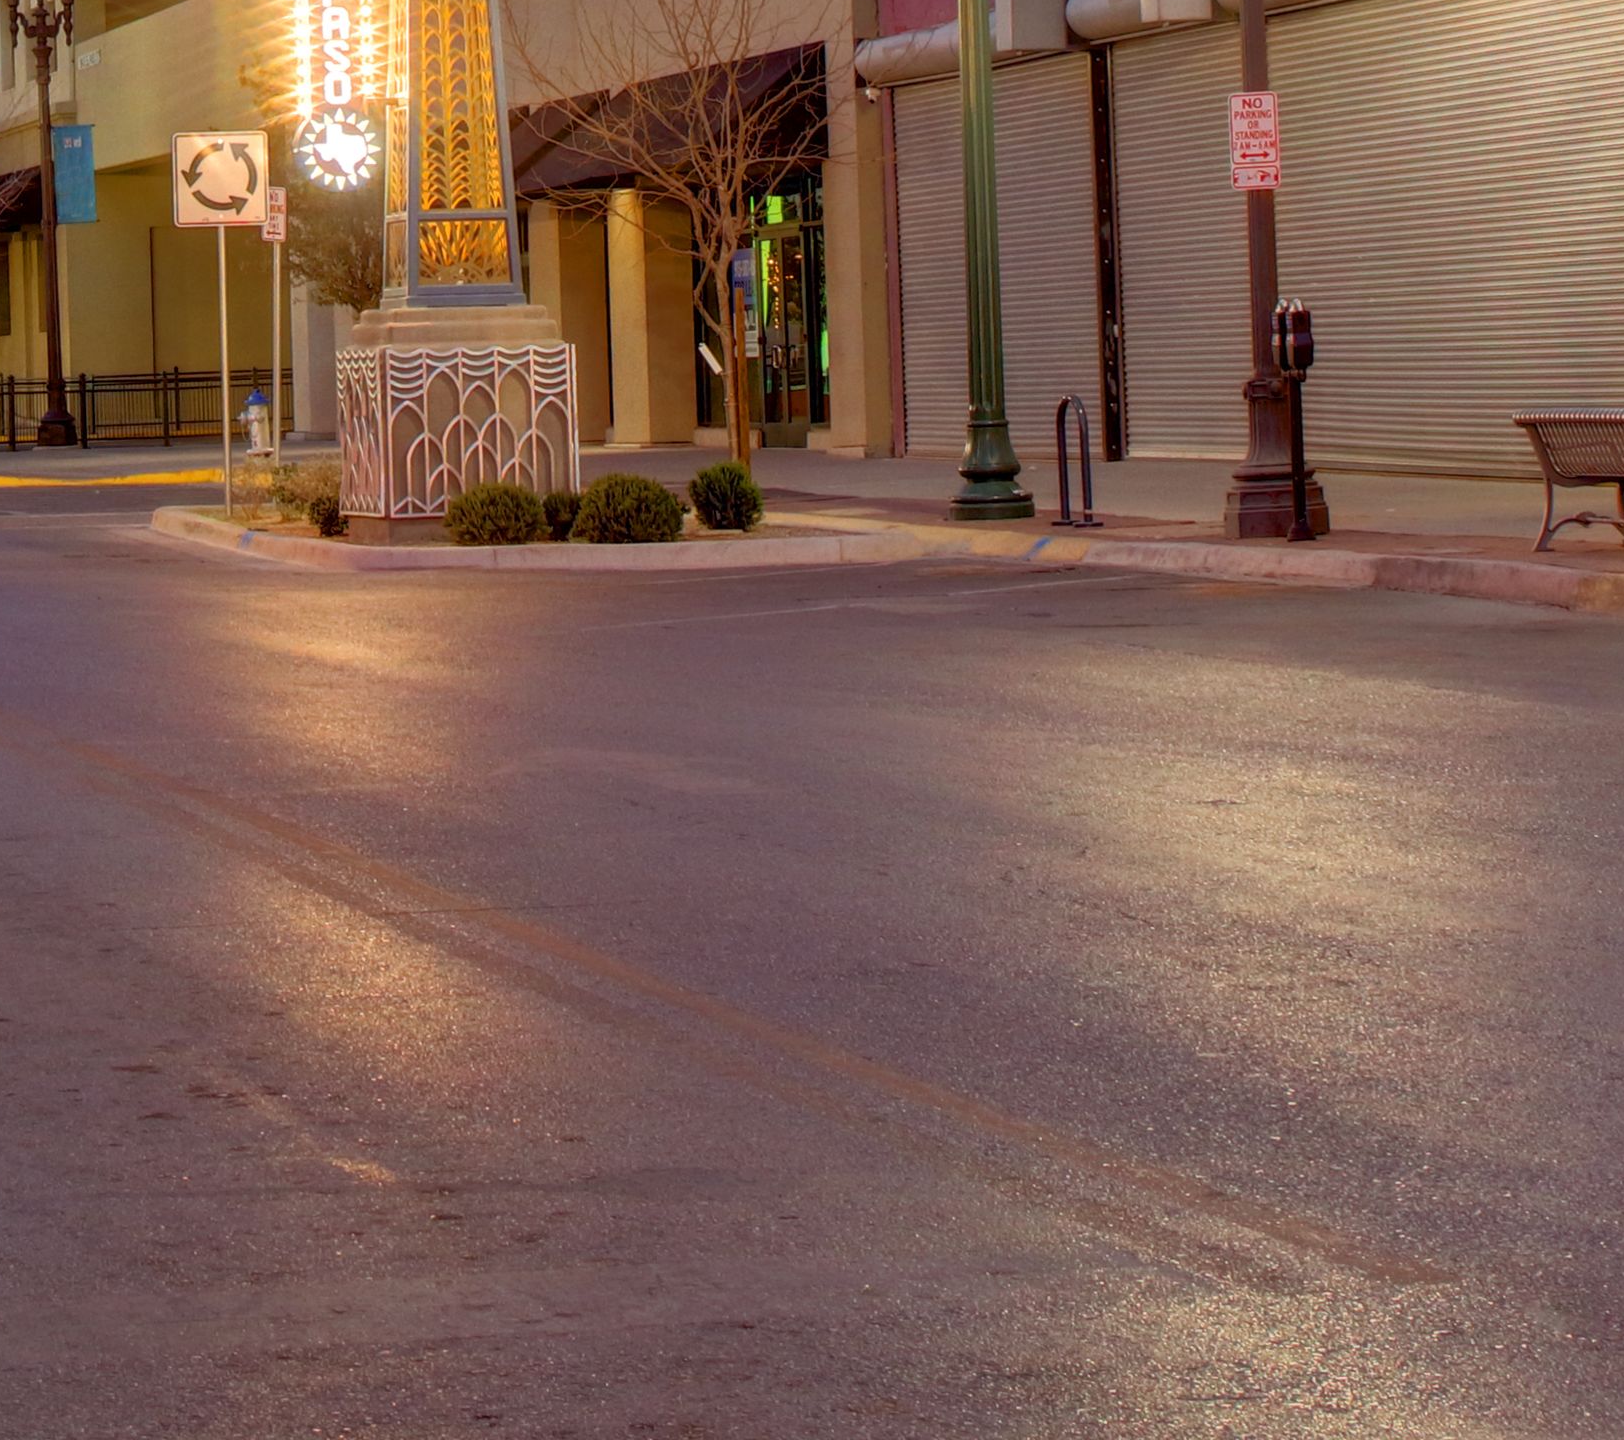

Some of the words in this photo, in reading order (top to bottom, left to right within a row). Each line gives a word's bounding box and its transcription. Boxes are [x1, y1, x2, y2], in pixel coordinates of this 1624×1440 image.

[1241, 97, 1263, 109] NO
[1234, 109, 1272, 120] PARKING
[1247, 120, 1259, 129] OR
[1234, 129, 1274, 140] STANDING
